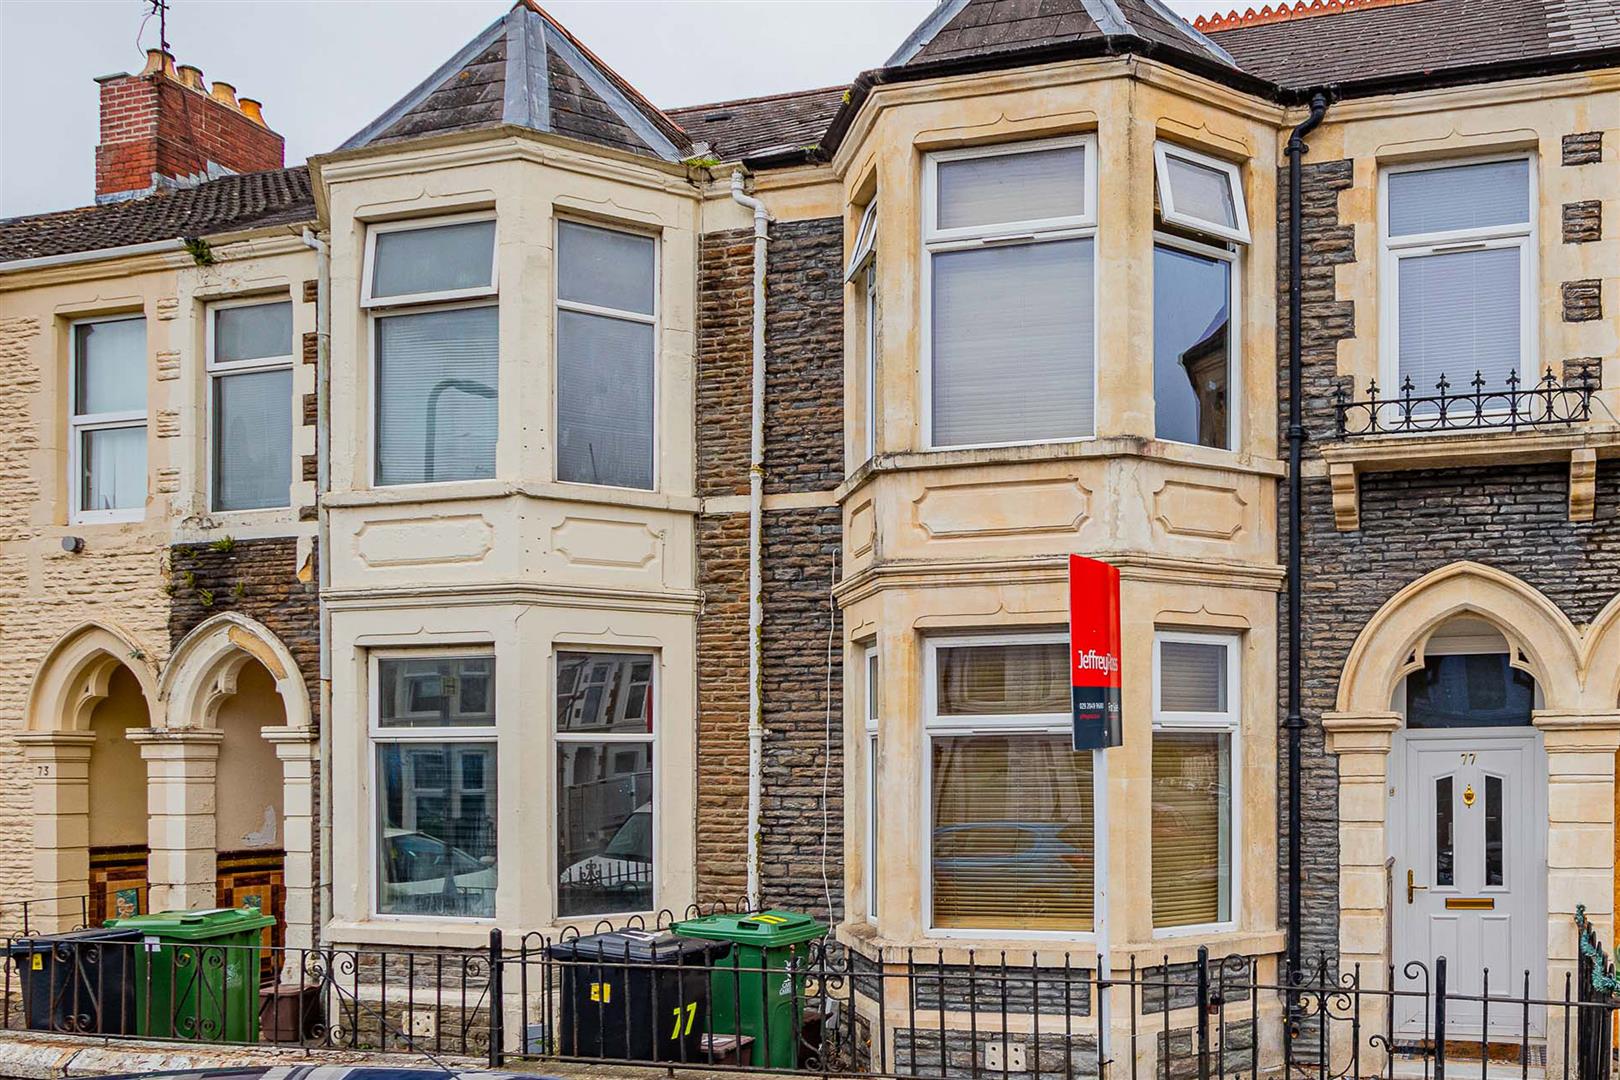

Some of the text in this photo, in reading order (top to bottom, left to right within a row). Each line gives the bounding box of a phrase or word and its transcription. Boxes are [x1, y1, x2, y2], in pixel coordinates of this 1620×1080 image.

[1461, 753, 1477, 766] 77
[37, 766, 49, 776] 73
[671, 1001, 697, 1040] 77
